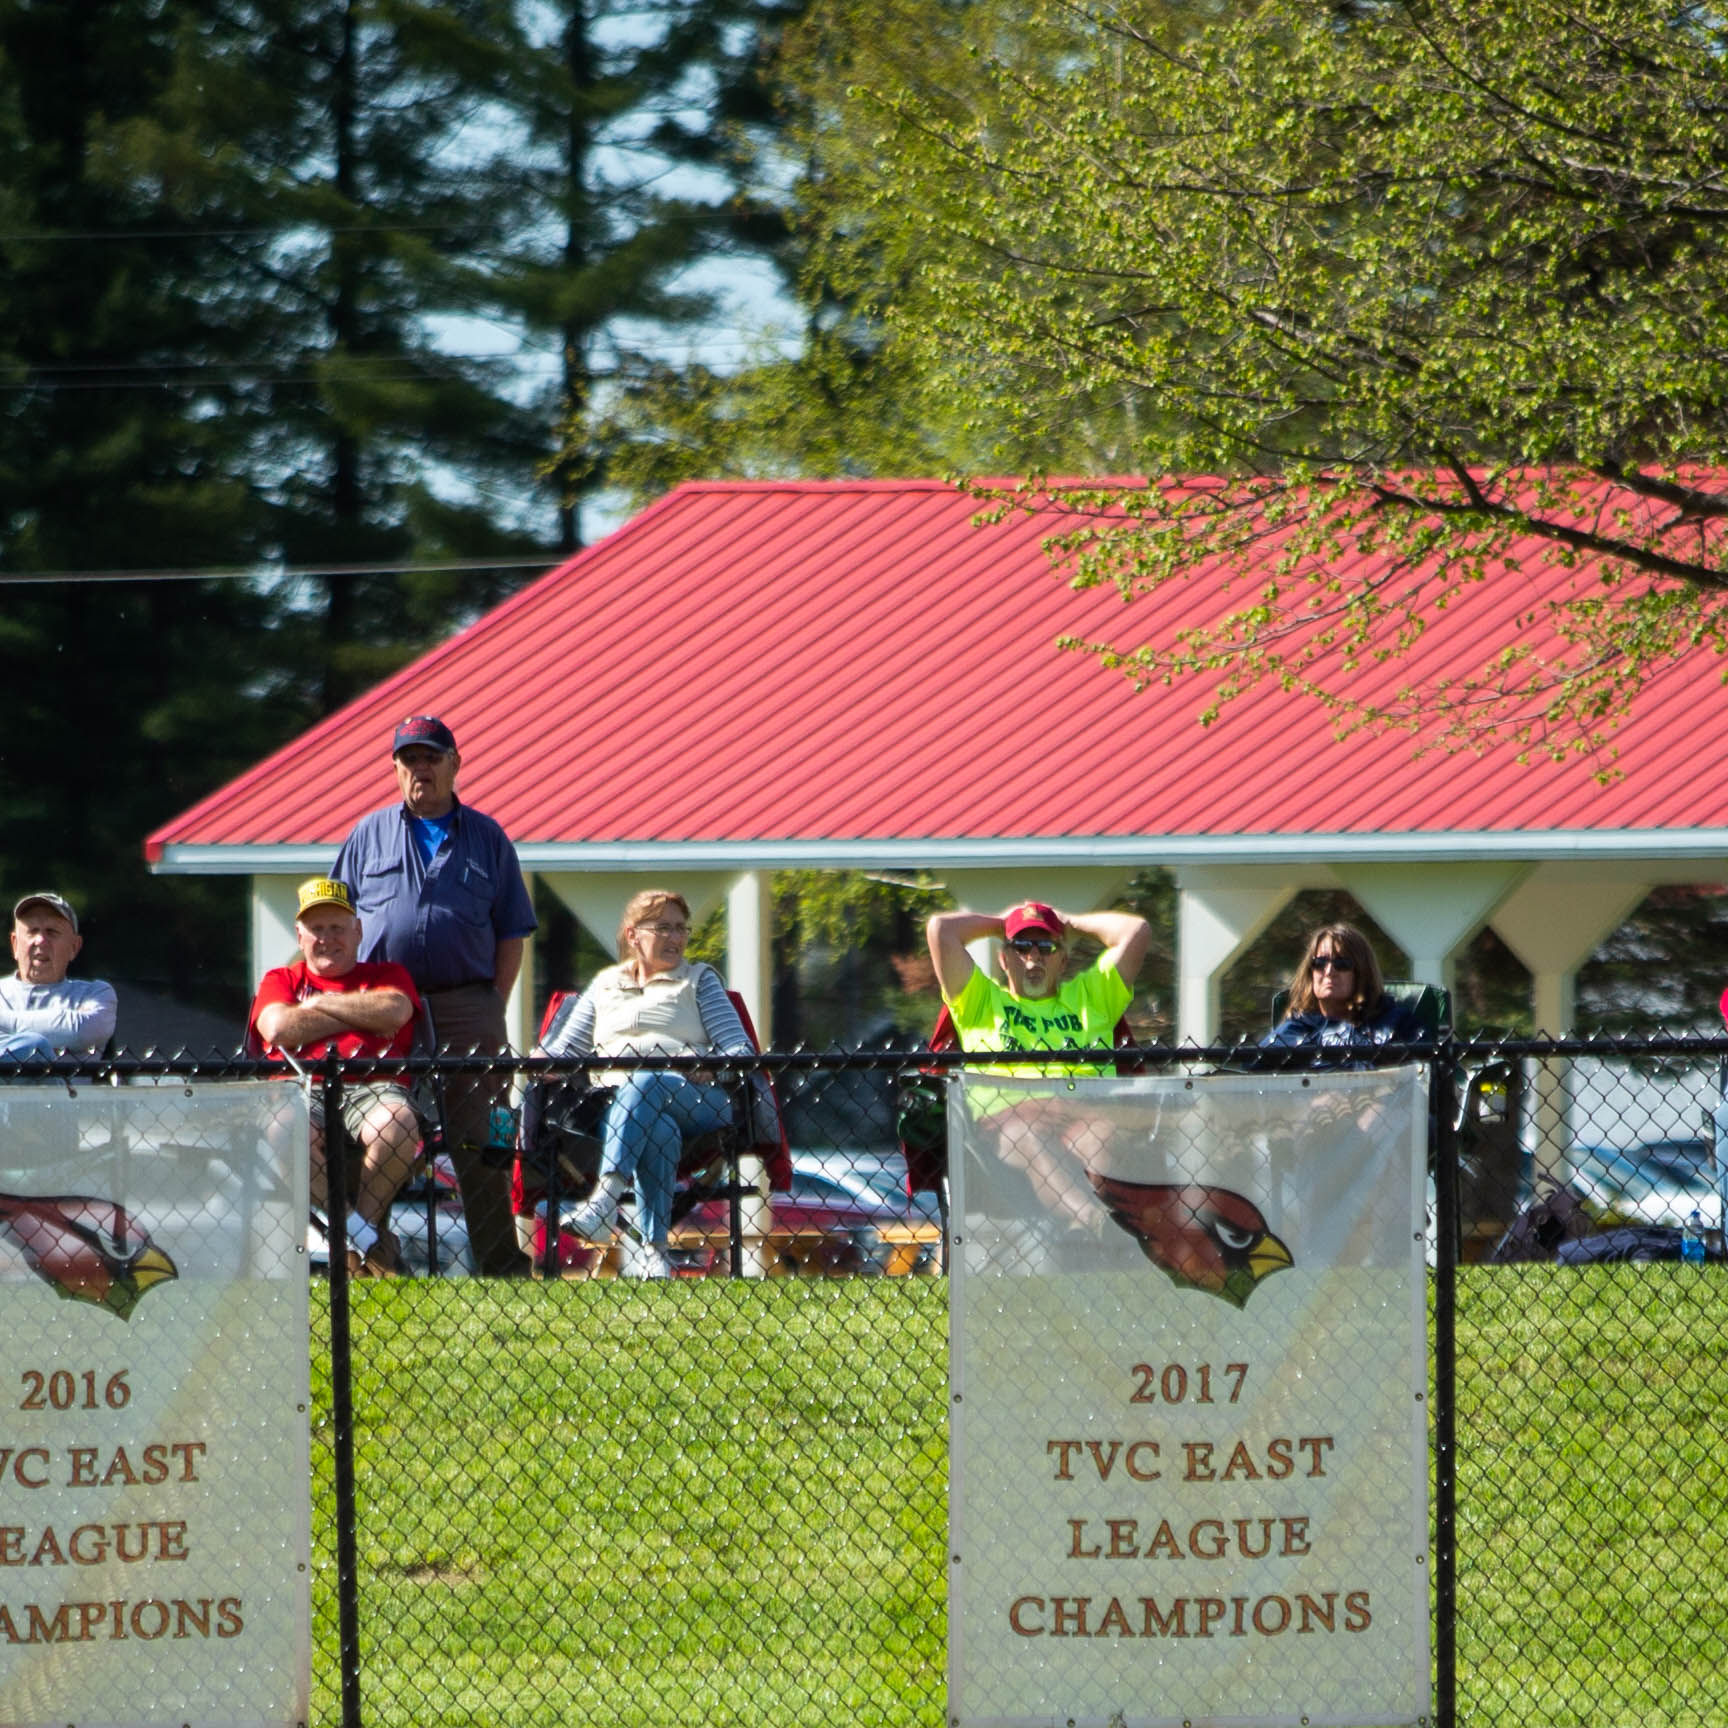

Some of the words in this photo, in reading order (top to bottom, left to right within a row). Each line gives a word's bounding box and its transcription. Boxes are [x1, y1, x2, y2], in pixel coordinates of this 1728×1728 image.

[300, 881, 348, 902] CHIGAN
[1041, 1013, 1083, 1034] PUB
[20, 1369, 132, 1411] 2016
[1129, 1363, 1250, 1404] 2017
[67, 1442, 207, 1487] EAST
[1047, 1440, 1162, 1482] TVC
[1182, 1437, 1335, 1481] EAST
[1066, 1518, 1312, 1560] LEAGUE
[1009, 1591, 1373, 1638] CHAMPIONS
